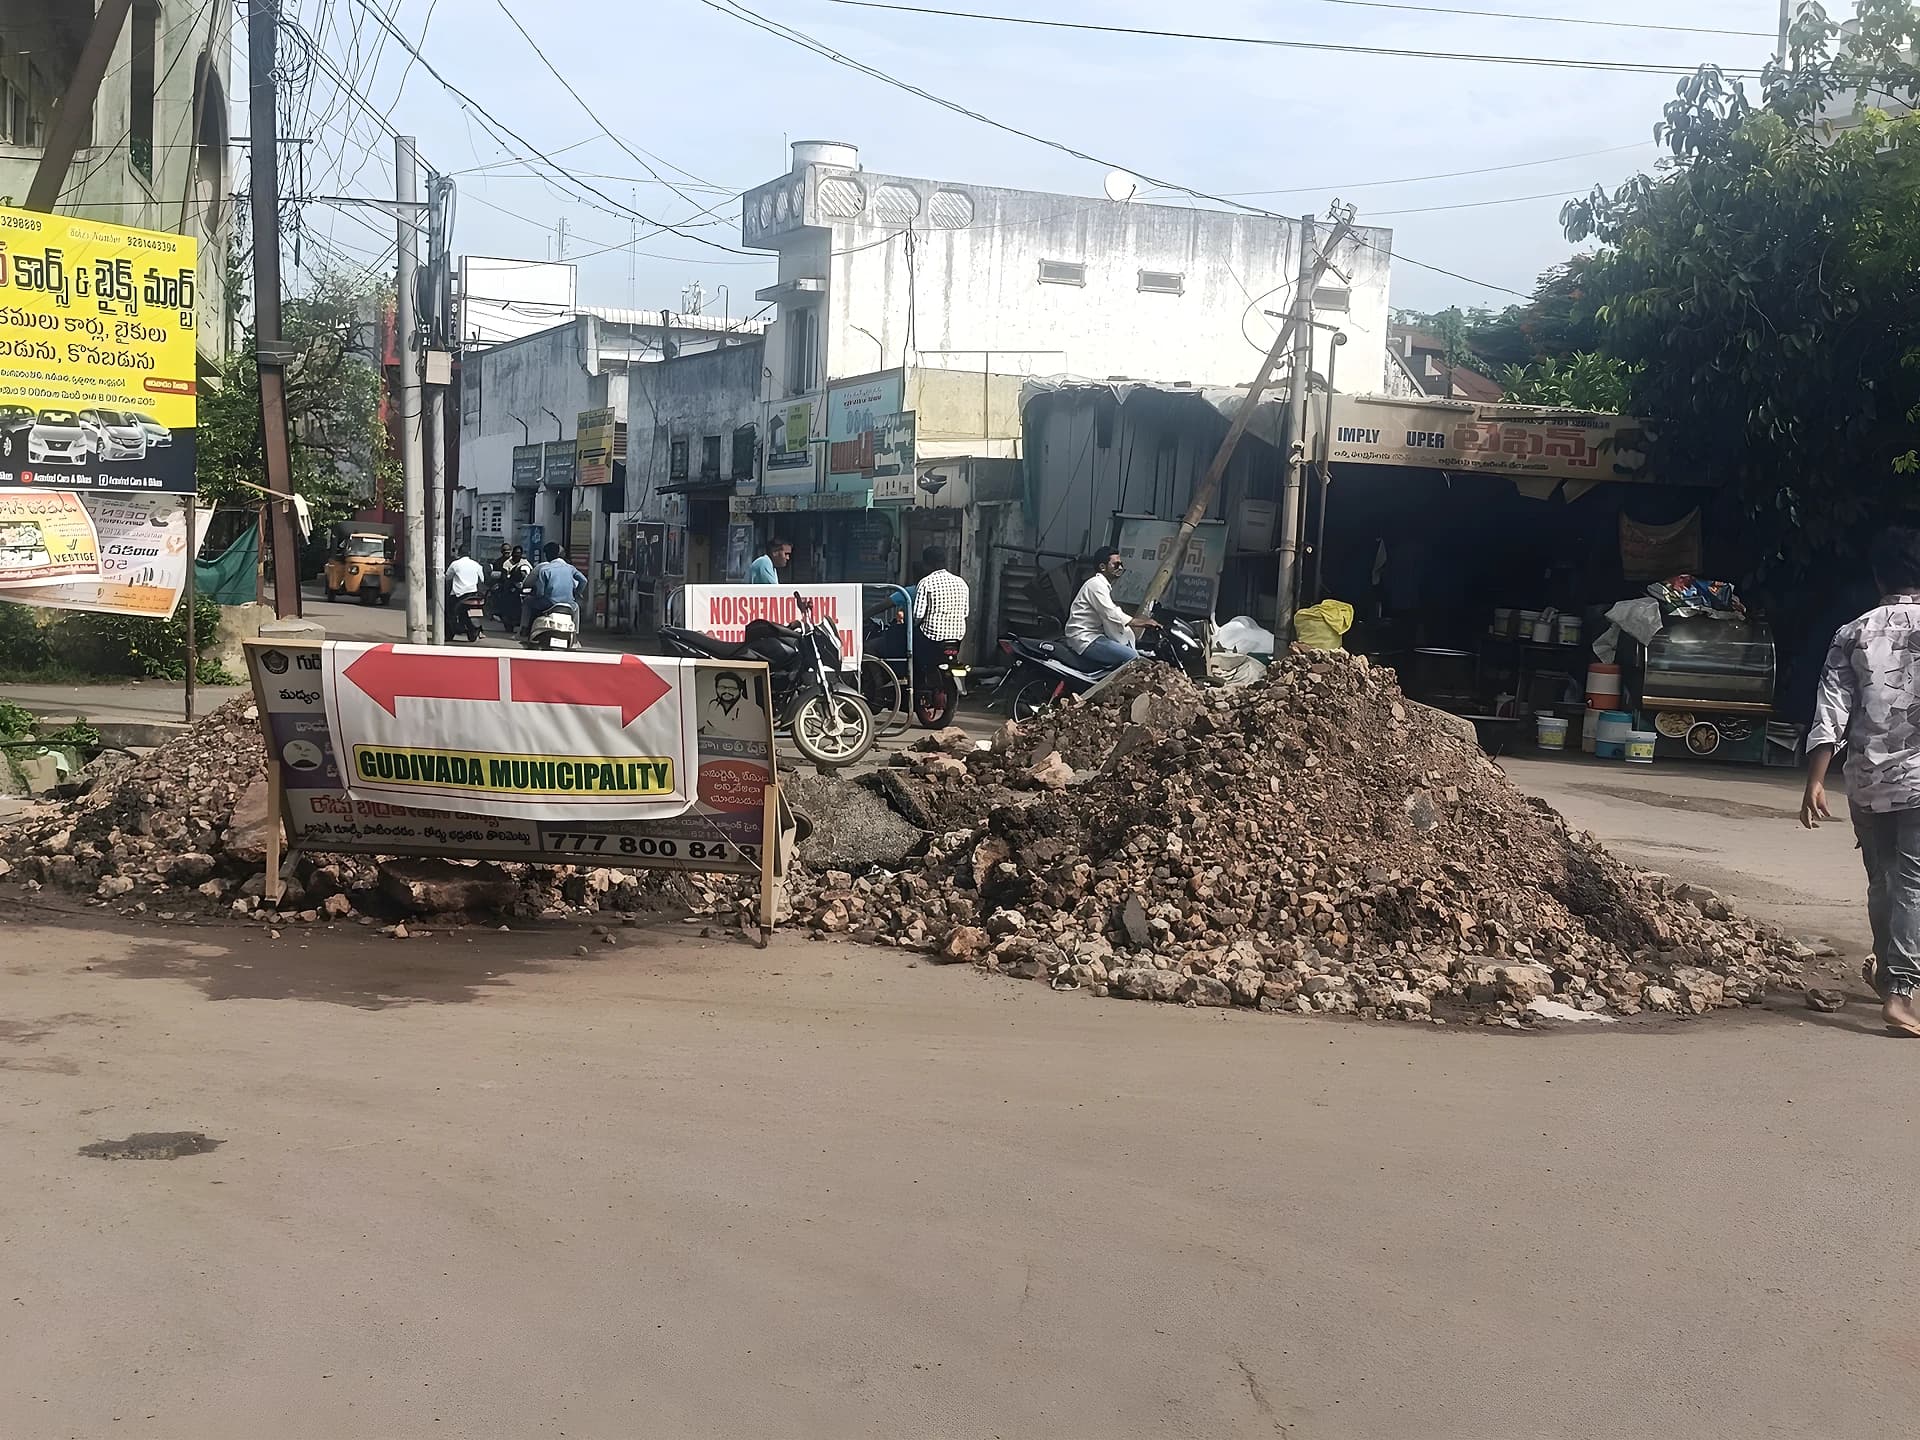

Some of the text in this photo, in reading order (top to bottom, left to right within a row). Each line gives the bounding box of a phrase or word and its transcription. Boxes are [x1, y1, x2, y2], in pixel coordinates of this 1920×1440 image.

[13, 248, 69, 307] కార్స్
[76, 267, 90, 297] &
[95, 258, 138, 316] బైక్స్
[144, 268, 195, 328] మార్ట్
[115, 321, 167, 345] బైకులు
[68, 343, 155, 370] కొనబడును
[359, 750, 485, 787] GUDIVADA
[490, 759, 669, 791] MUNICIPALITY
[548, 833, 607, 851] 777
[619, 837, 677, 857] 800
[688, 841, 728, 860] 84
